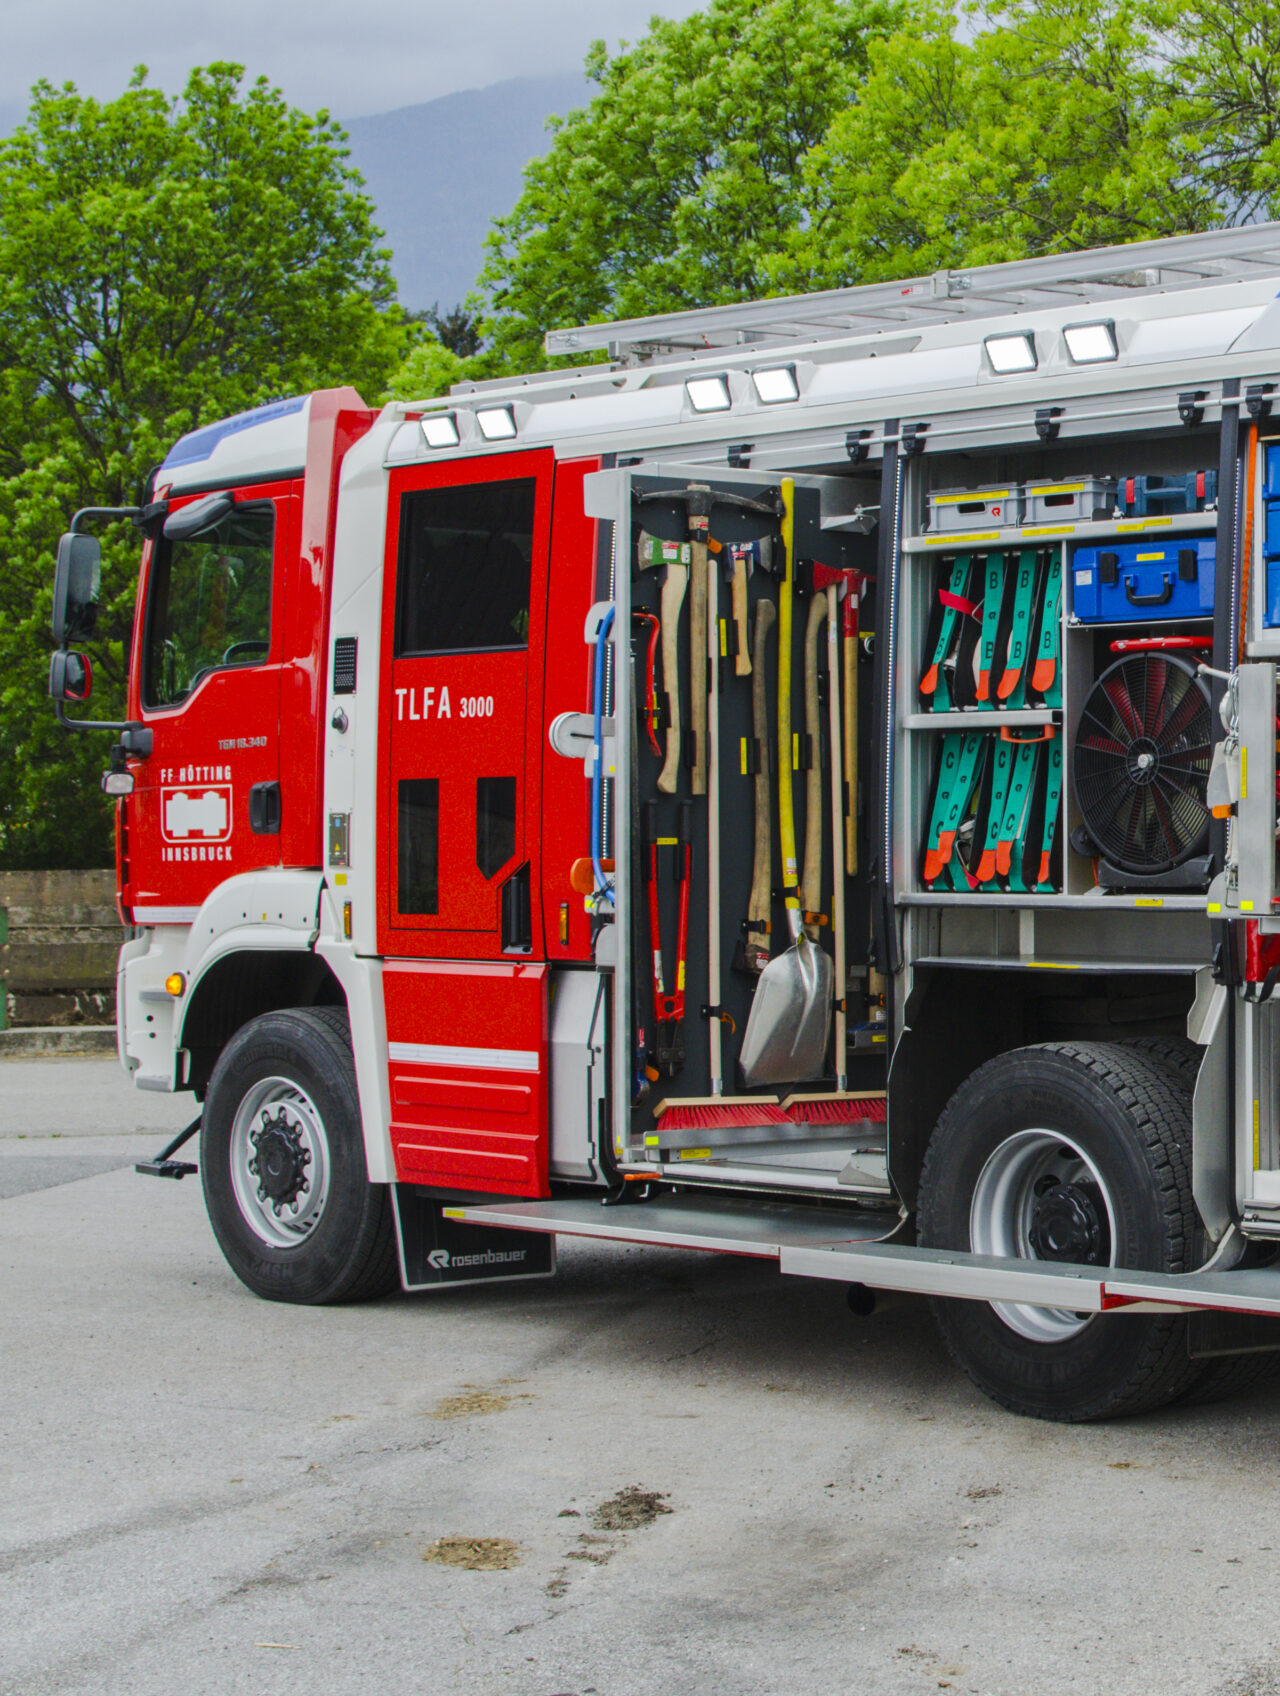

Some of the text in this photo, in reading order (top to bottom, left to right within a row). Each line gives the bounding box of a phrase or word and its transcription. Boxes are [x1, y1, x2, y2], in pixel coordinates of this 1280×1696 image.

[953, 569, 963, 587] B
[1052, 561, 1061, 578] B
[989, 571, 998, 589] B
[1020, 570, 1030, 588] B
[1043, 631, 1052, 648] B
[1014, 641, 1022, 659] B
[395, 686, 494, 721] TLFA 3000
[967, 737, 976, 754] C
[1022, 744, 1031, 761] C
[946, 752, 955, 769] C
[998, 751, 1006, 768] C
[1053, 750, 1061, 768] C
[161, 764, 231, 783] FF HÖTTING
[950, 804, 958, 820] C
[991, 822, 998, 839] C
[1006, 814, 1015, 831] C
[162, 846, 232, 862] INNSBRUCK
[451, 1249, 527, 1267] rosenbauer
